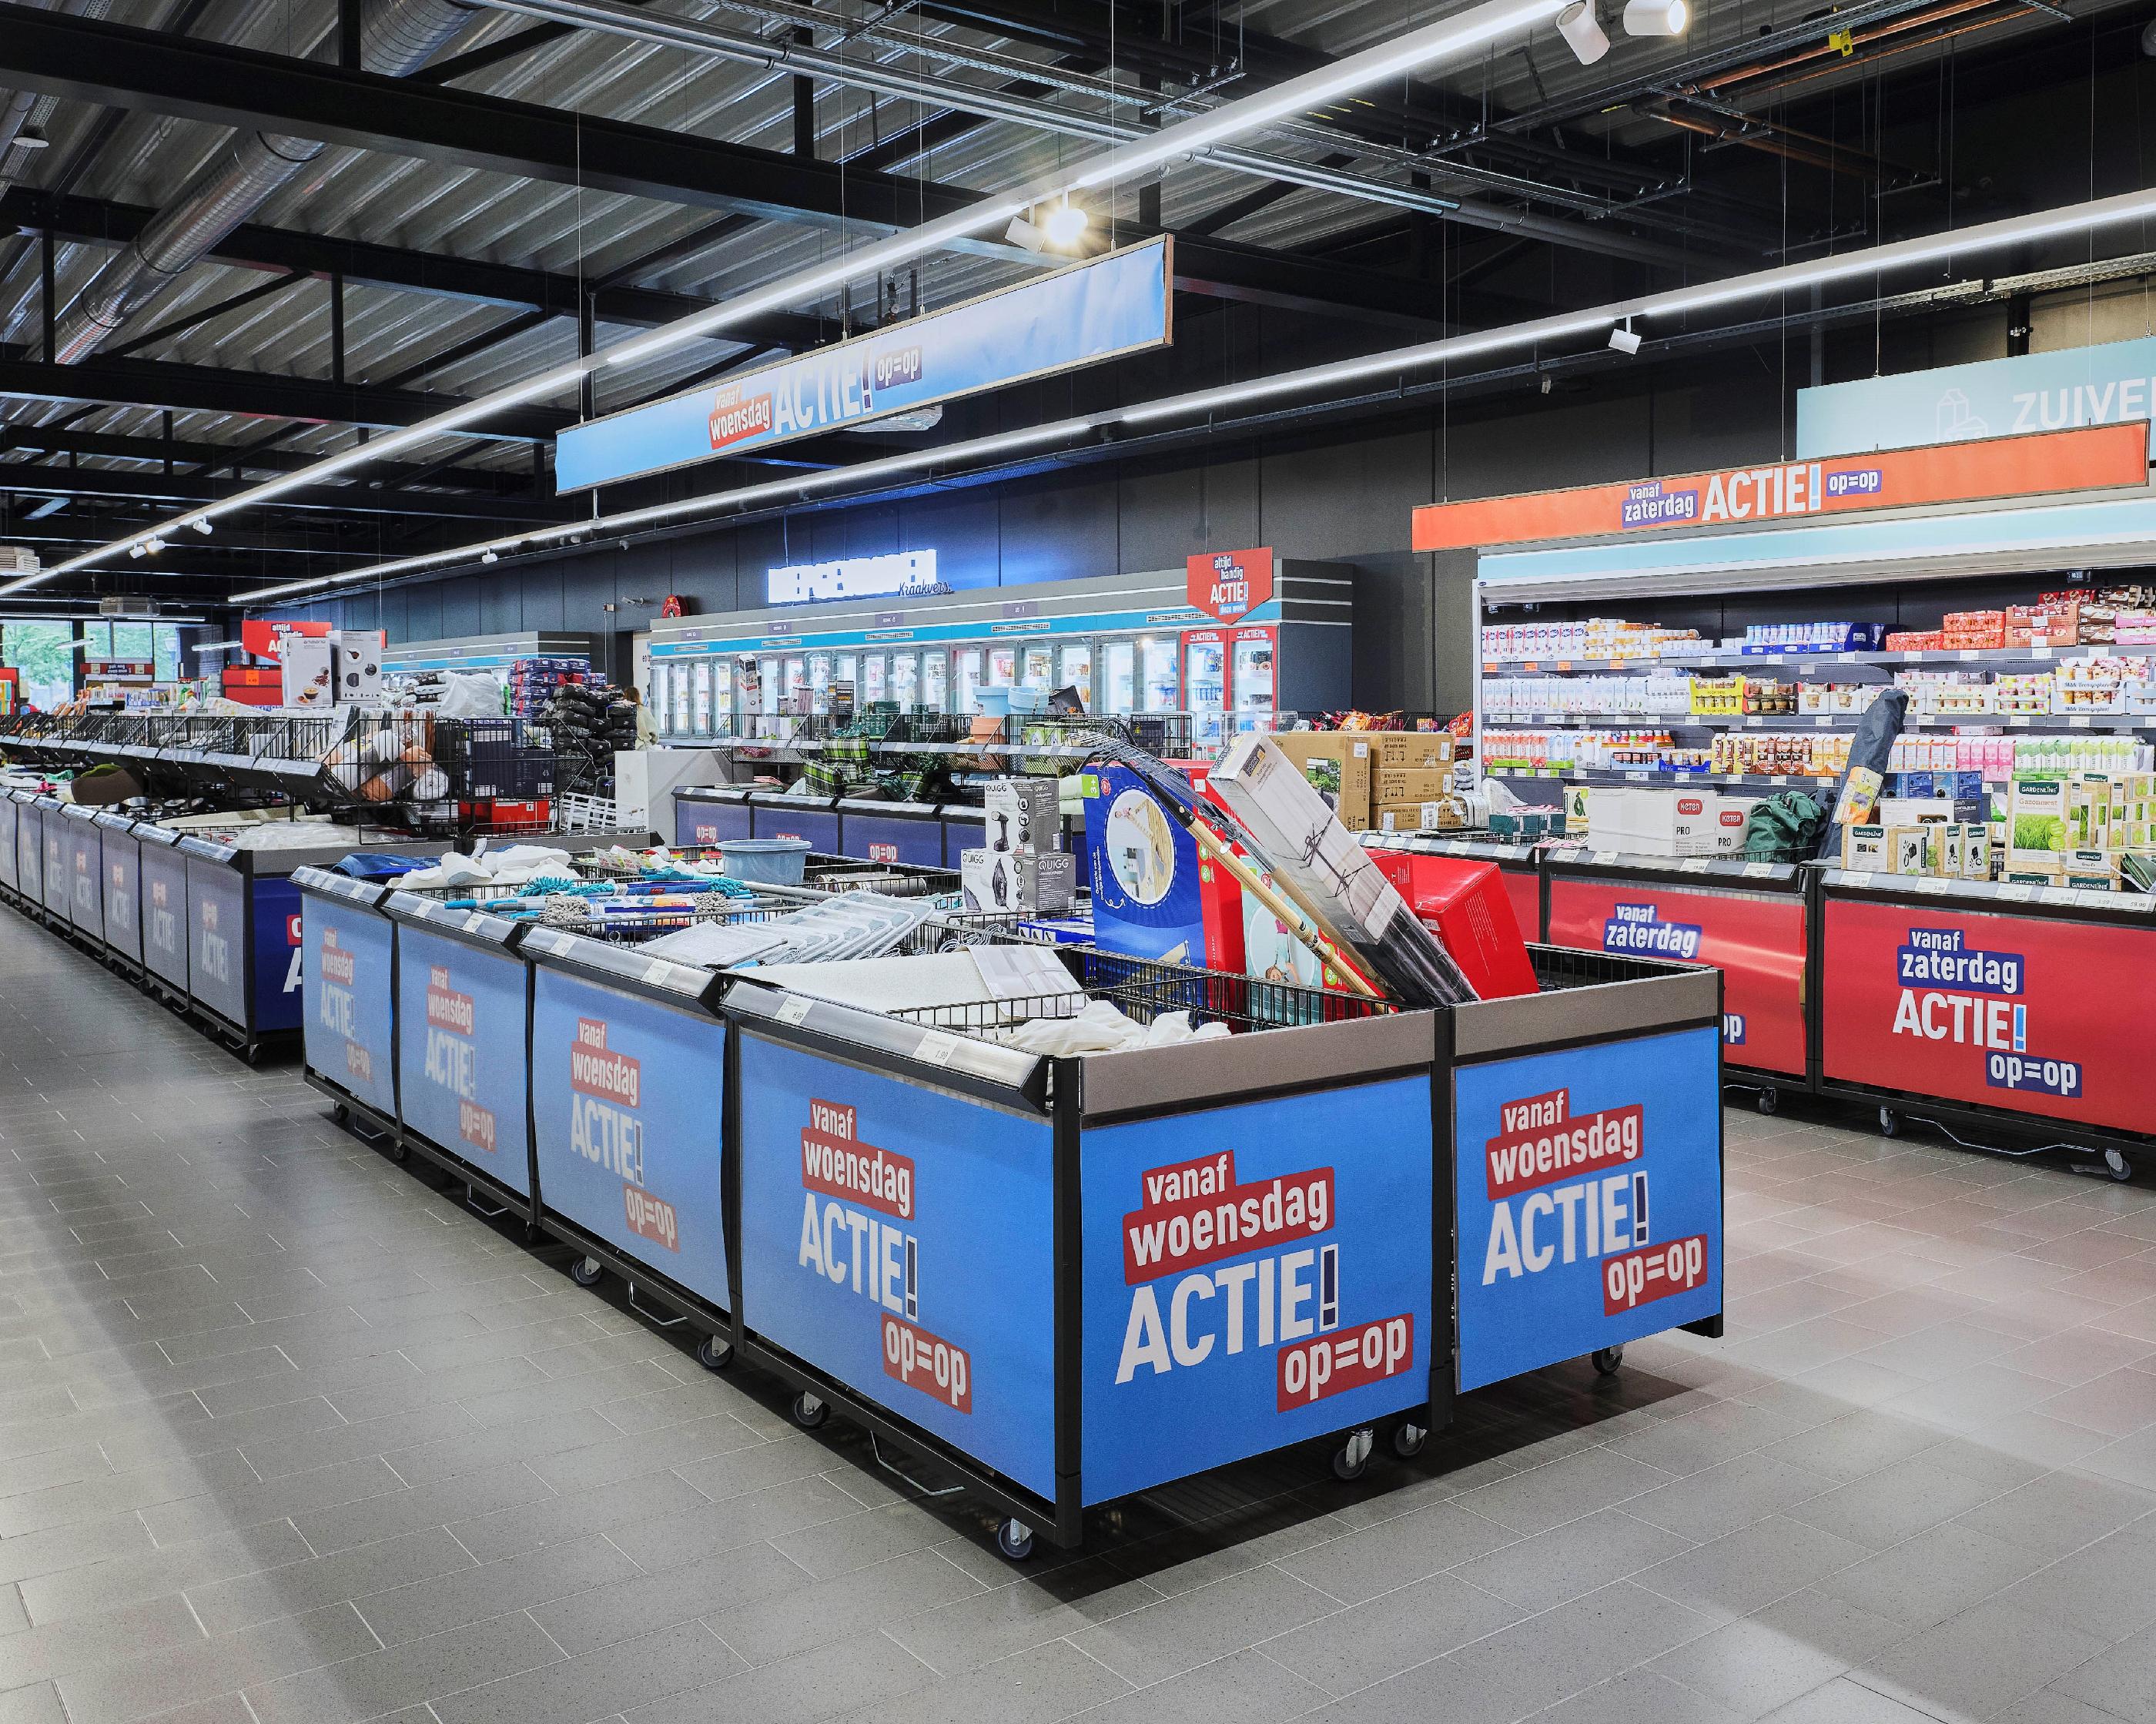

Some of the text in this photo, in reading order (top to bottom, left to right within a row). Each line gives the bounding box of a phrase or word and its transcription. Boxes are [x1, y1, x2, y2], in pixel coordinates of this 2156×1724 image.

[877, 349, 919, 385] op=op
[716, 387, 740, 409] vanaf
[775, 348, 873, 434] ACTIE!
[2012, 377, 2156, 434] ZUIVE
[711, 399, 770, 440] woensdag
[1630, 484, 1660, 500] vanaf
[1702, 464, 1821, 521] ACTIE!
[1829, 471, 1878, 494] op=op
[1625, 494, 1694, 522] zaterdag
[1214, 556, 1231, 569] altijd
[1221, 567, 1243, 580] handig
[1210, 581, 1248, 604] ACTIE!
[272, 624, 290, 632] altijd
[697, 826, 717, 843] op=op
[1676, 826, 1690, 835] PRO
[1718, 838, 1732, 846] PRO
[869, 844, 898, 862] op=op
[962, 853, 984, 864] QUIGG
[1038, 859, 1069, 870] QUIGG
[2071, 882, 2108, 890] GARDENLINE
[1617, 904, 1655, 923] vanaf
[324, 929, 336, 947] vanaf
[1606, 923, 1698, 958] zaterdag
[1911, 929, 1960, 952] vanaf
[322, 949, 353, 986] woensdag
[431, 968, 448, 989] vanaf
[1902, 951, 2018, 994] zaterdag
[320, 982, 355, 1039] ACTIE!
[427, 990, 473, 1035] woensdag
[1893, 989, 2027, 1053] ACTIE!
[579, 1022, 605, 1049] vanaf
[346, 1041, 370, 1078] op=op
[425, 1027, 475, 1100] ACTIE!
[572, 1050, 638, 1106] woensdag
[1990, 1054, 2077, 1095] op=op
[460, 1103, 494, 1150] op=op
[812, 1103, 852, 1141] vanaf
[1504, 1091, 1565, 1133] vanaf
[571, 1094, 644, 1187] ACTIE!
[1490, 1113, 1638, 1185] woensdag
[804, 1139, 910, 1218] woensdag
[1147, 1153, 1227, 1205] vanaf
[625, 1189, 676, 1247] op=op
[1129, 1179, 1327, 1267] woensdag
[1482, 1170, 1649, 1286] ACTIE!
[798, 1192, 918, 1322] ACTIE!
[1608, 1237, 1702, 1307] op=op
[1114, 1243, 1339, 1385] ACTIE!
[886, 1321, 966, 1406] op=op
[1284, 1318, 1407, 1400] op=op
